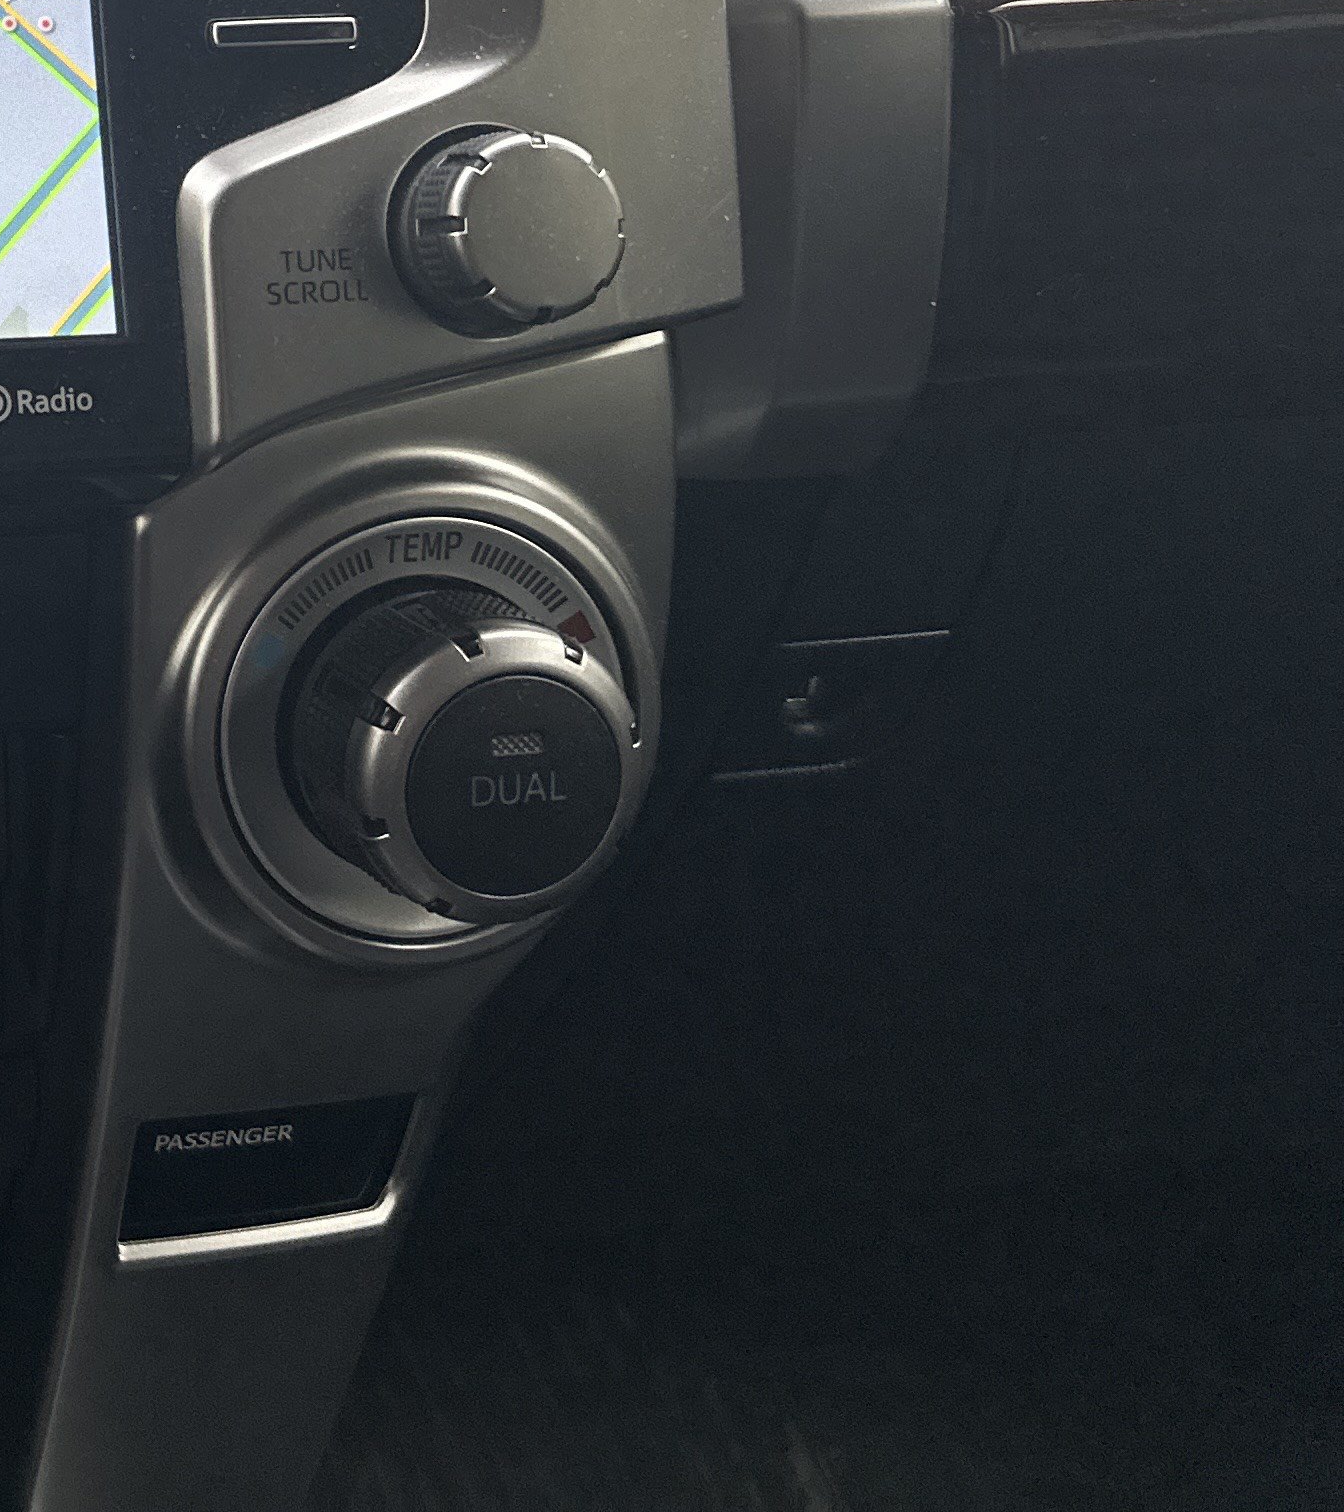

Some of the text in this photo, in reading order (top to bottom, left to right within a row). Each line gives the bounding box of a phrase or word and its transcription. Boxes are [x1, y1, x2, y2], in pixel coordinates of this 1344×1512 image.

[280, 248, 354, 273] TUNE
[267, 281, 369, 306] SCROLL
[18, 387, 93, 415] Radio
[385, 531, 464, 563] TEMP
[470, 772, 567, 805] DUAL
[154, 1124, 293, 1152] PASSENGER
